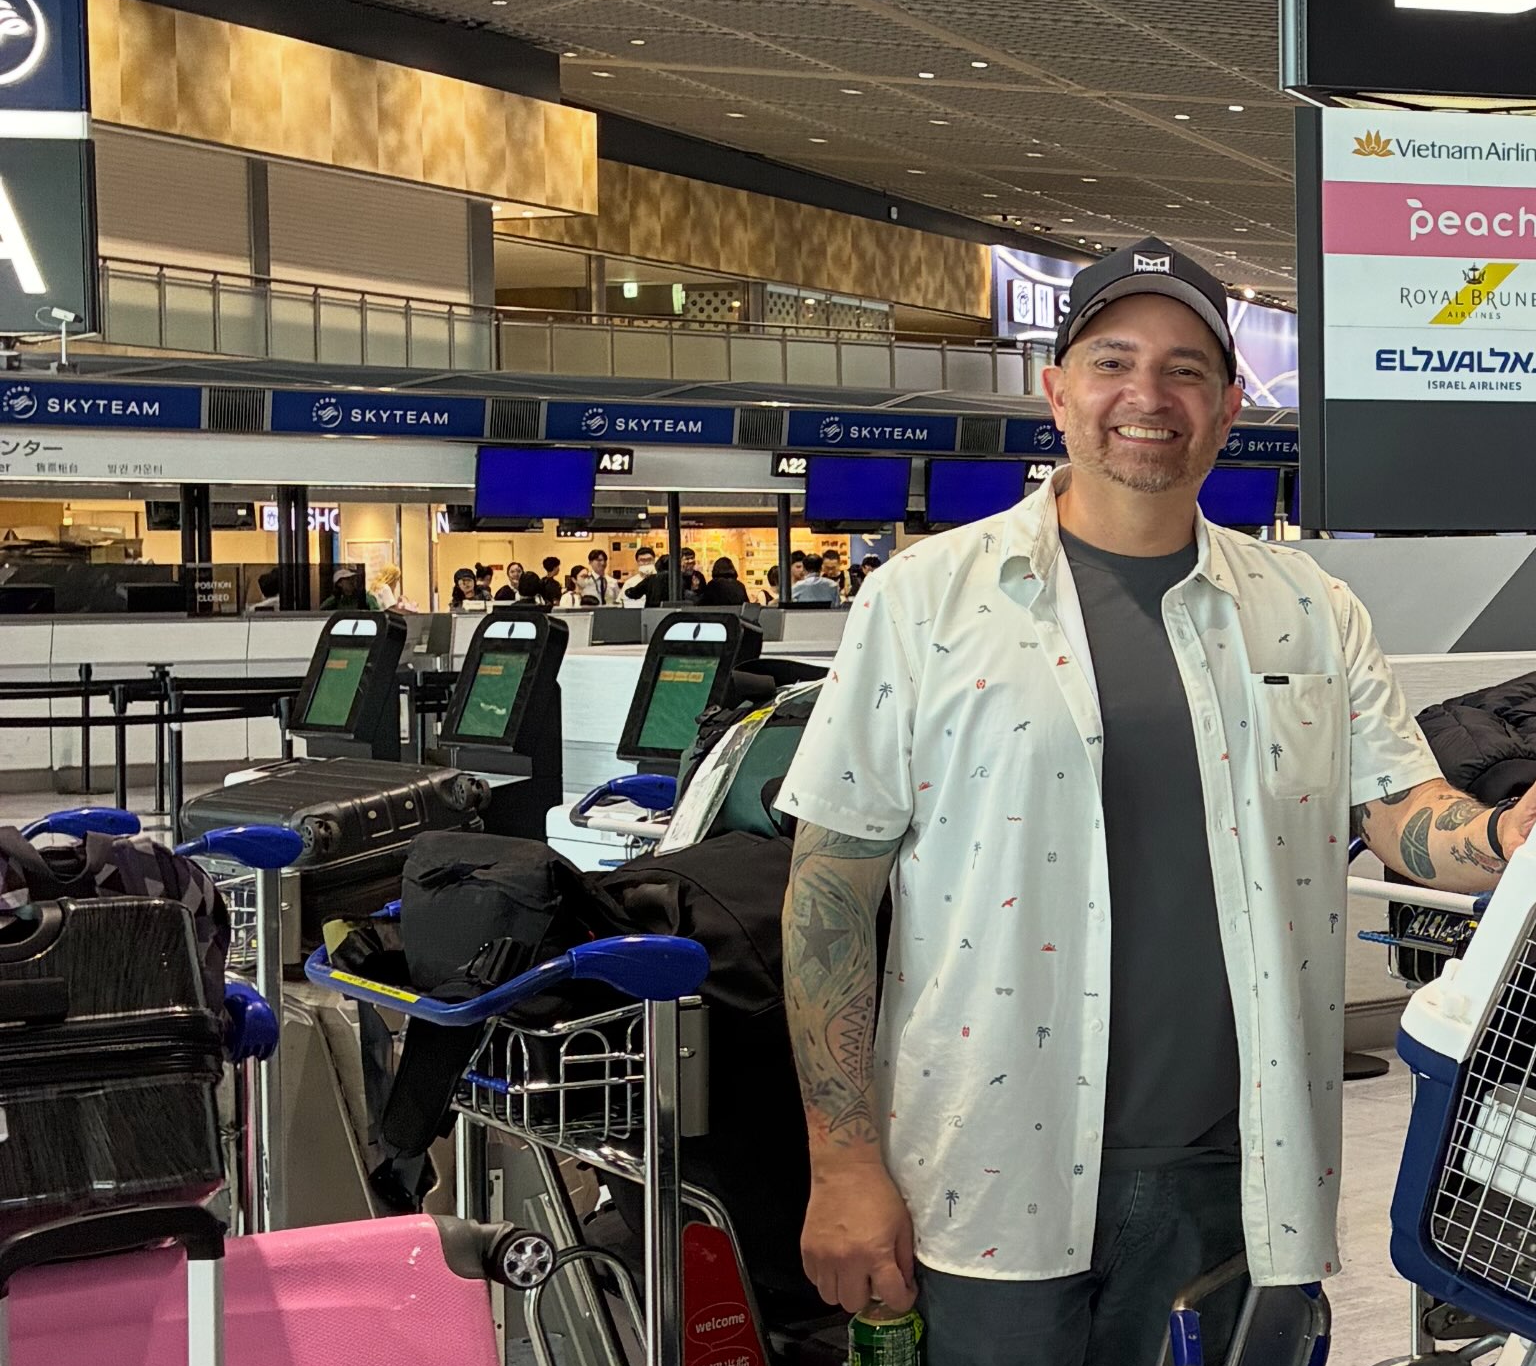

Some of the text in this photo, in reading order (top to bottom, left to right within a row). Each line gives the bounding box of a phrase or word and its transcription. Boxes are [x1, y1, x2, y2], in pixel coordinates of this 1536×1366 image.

[1395, 137, 1483, 161] Vietnam
[1400, 286, 1464, 309] ROYAL
[1447, 310, 1502, 320] AIRLINES
[1427, 379, 1523, 392] ISRAEL AIRLINES
[47, 397, 160, 417] SKYTEAM
[351, 408, 449, 425] SKYTEAM
[615, 418, 702, 433] SKYTEAM
[849, 426, 929, 441] SKYTEAM
[1248, 440, 1299, 453] SKYTEA
[599, 454, 630, 471] A21
[778, 457, 807, 474] A22
[194, 581, 232, 591] POSITION
[197, 592, 230, 603] CLOSED
[695, 1312, 746, 1334] welcome
